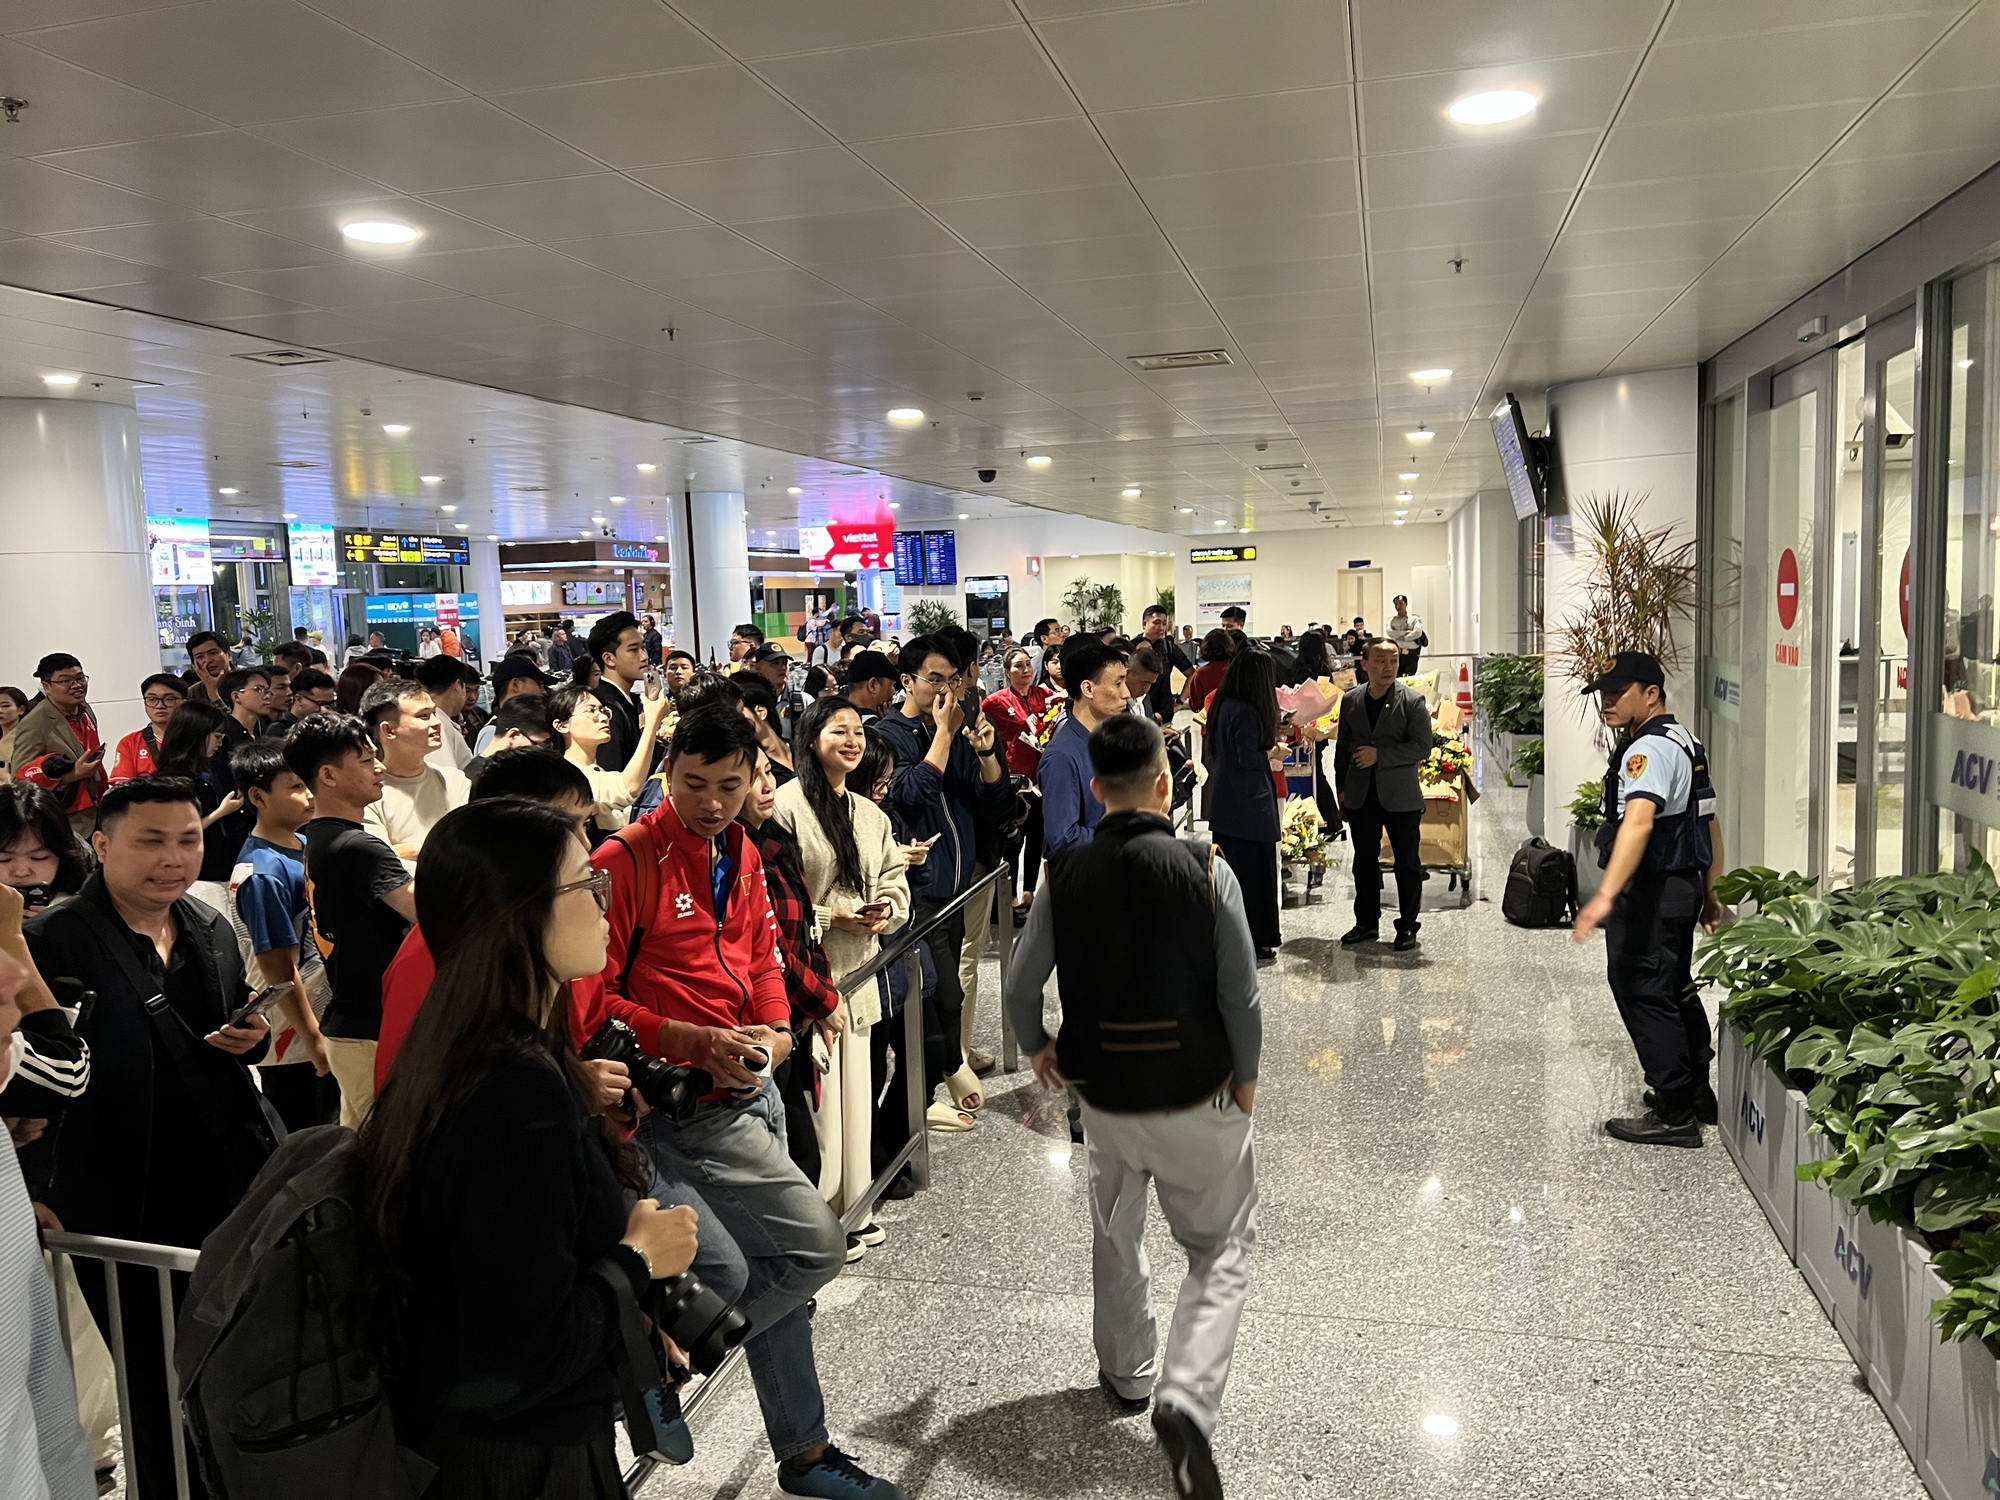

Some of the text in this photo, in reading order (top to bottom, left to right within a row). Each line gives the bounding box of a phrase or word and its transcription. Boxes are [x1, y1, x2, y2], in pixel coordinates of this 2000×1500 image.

[842, 532, 879, 543] viettel
[174, 617, 196, 628] Sinh
[1714, 676, 1728, 701] ACV
[1951, 749, 1993, 795] ACV
[1741, 1090, 1765, 1147] ACV
[1834, 1225, 1873, 1300] ACV
